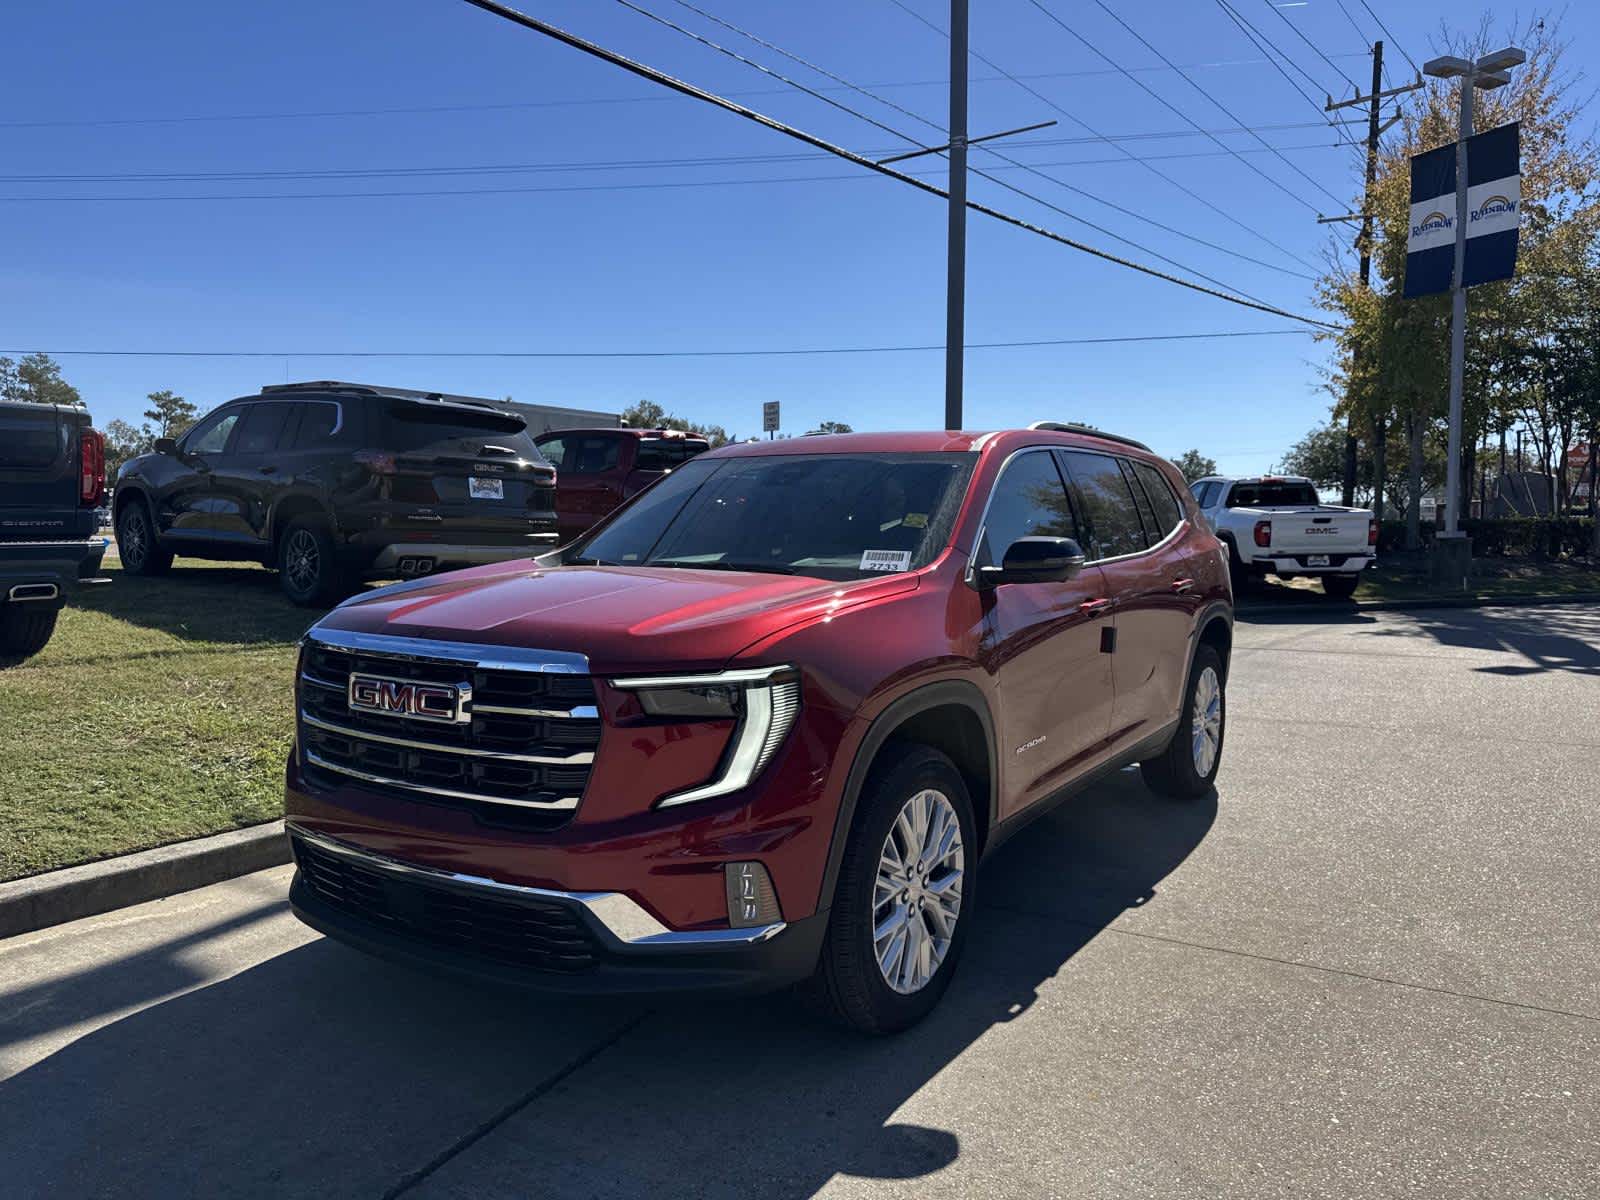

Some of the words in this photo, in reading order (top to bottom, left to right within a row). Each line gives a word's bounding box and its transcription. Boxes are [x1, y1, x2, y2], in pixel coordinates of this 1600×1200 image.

[1469, 200, 1517, 223] RAINBOW
[1411, 217, 1454, 238] RAINBOW
[1305, 527, 1340, 535] GMC
[869, 562, 898, 570] 2733
[351, 680, 455, 719] GMC
